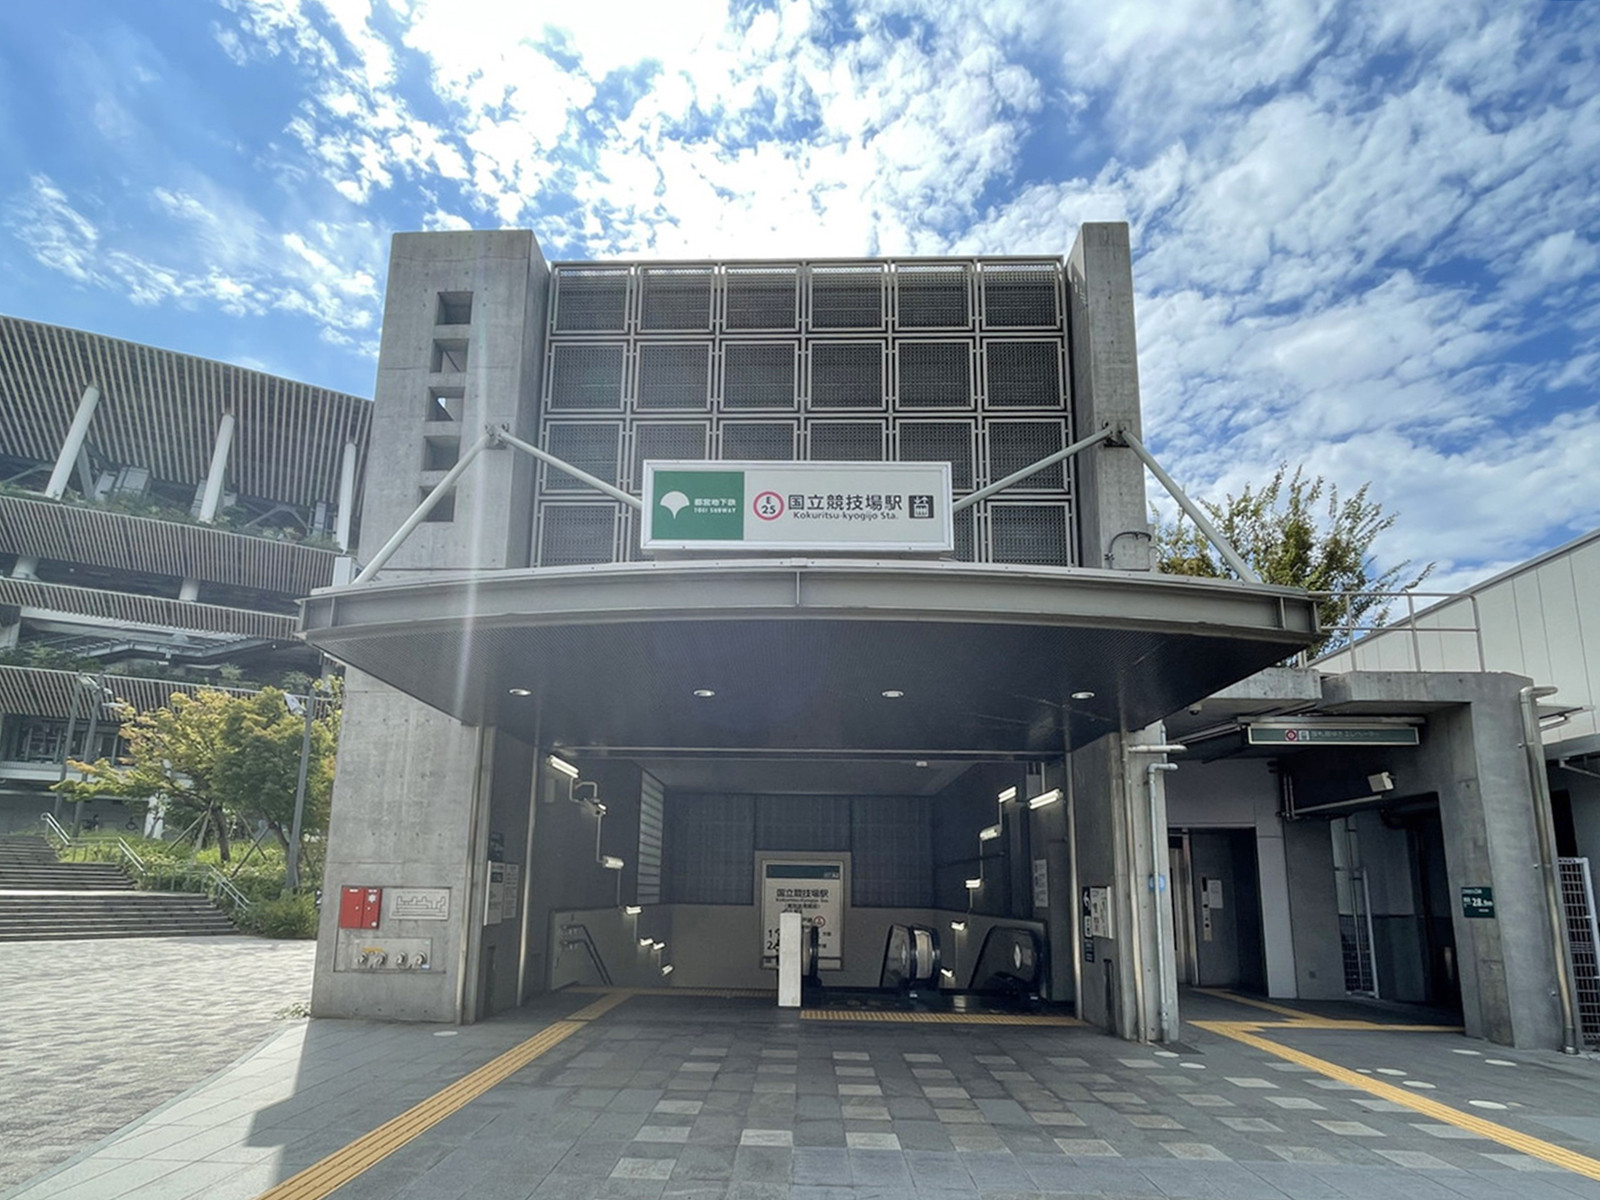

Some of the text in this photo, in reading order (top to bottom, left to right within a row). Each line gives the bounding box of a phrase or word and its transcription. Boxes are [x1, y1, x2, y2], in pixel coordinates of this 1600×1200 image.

[766, 496, 772, 505] E
[788, 494, 902, 511] 国立競技場駅
[761, 504, 776, 514] 25
[880, 511, 899, 520] Sta.
[776, 888, 829, 898] 国立競技場駅
